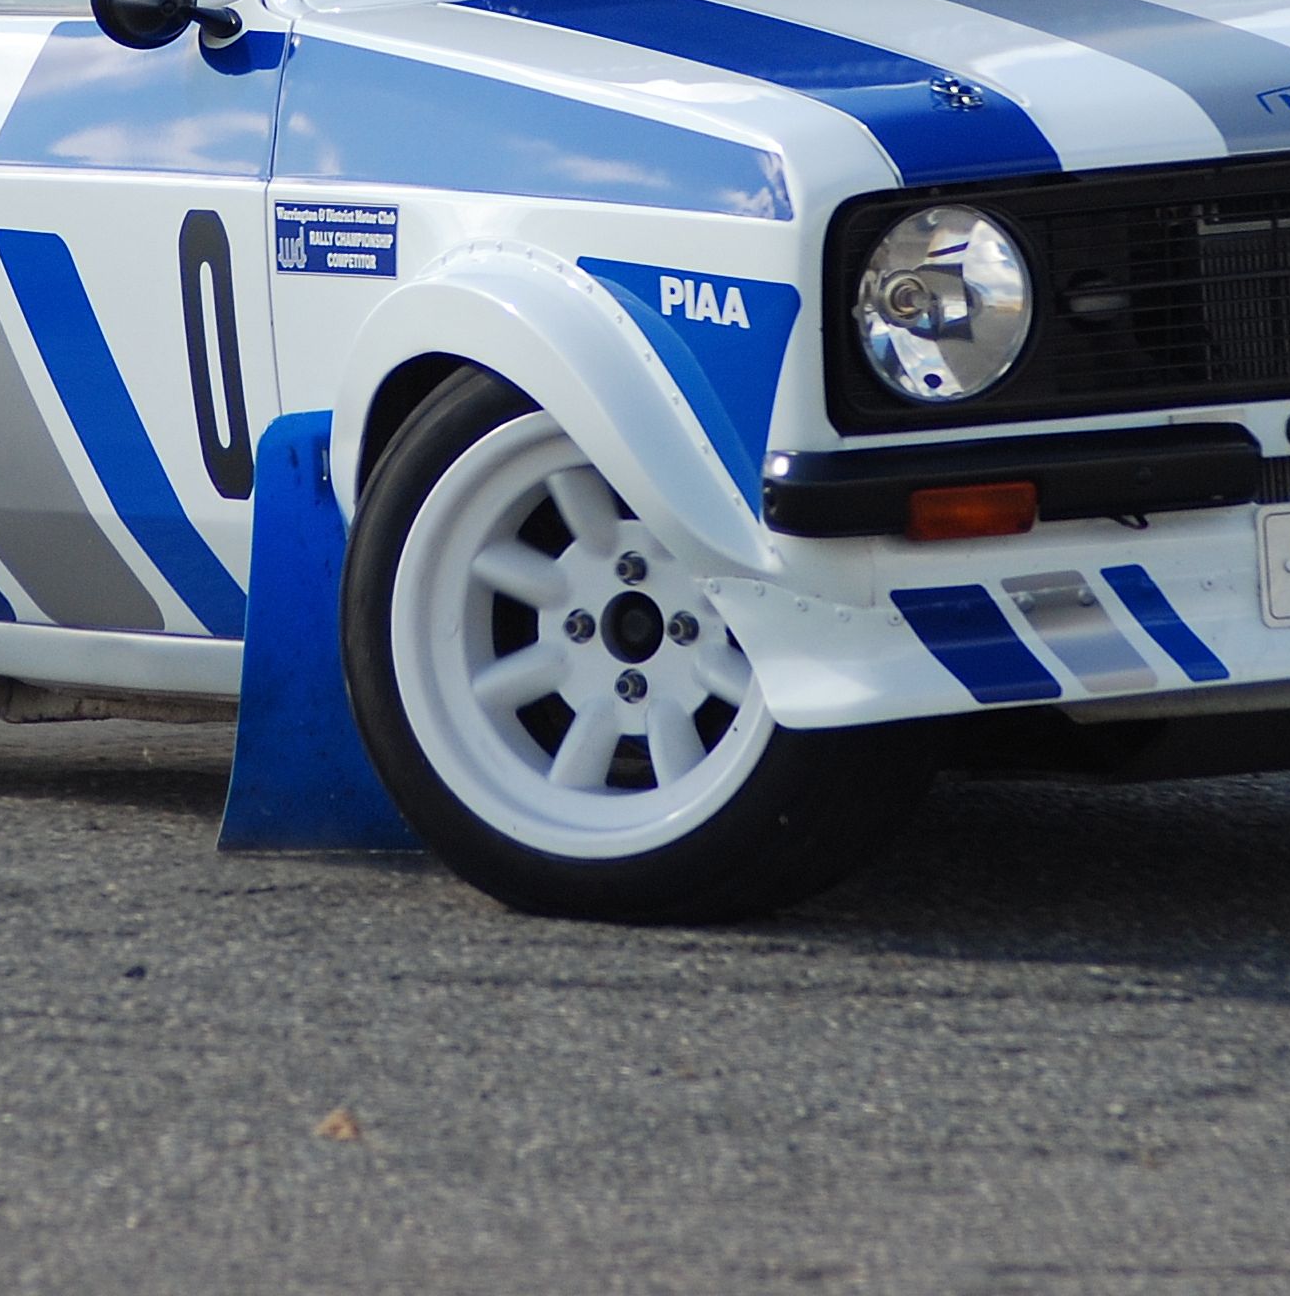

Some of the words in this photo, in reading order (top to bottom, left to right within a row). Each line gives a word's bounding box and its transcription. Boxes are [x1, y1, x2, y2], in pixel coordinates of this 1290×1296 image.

[309, 230, 334, 246] RALLY
[659, 275, 751, 329] PIAA
[178, 208, 256, 501] 0
